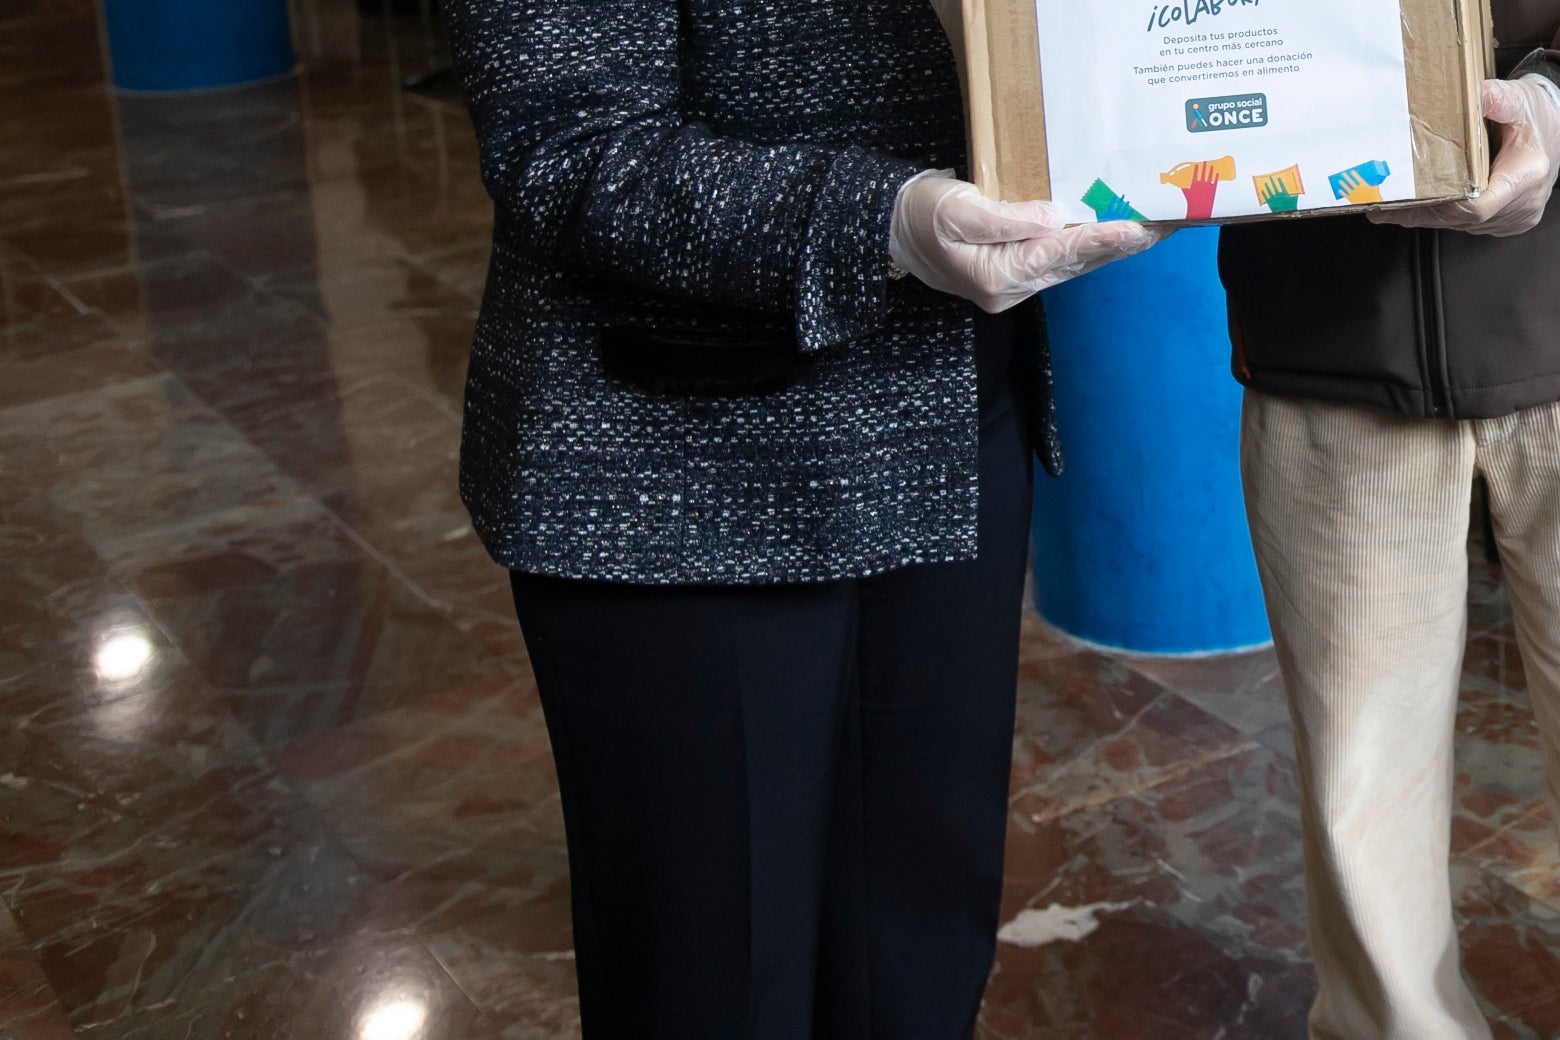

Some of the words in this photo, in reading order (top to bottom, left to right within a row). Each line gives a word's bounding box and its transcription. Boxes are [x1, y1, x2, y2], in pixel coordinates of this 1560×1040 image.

[1163, 33, 1207, 45] Deposita
[1210, 31, 1225, 41] tus
[1227, 27, 1278, 40] productos
[1159, 48, 1172, 56] en
[1174, 46, 1185, 55] tu
[1187, 44, 1219, 54] centro
[1221, 41, 1242, 51] más
[1244, 38, 1284, 49] cercano
[1133, 62, 1175, 75] También
[1177, 59, 1214, 72] puedes
[1216, 57, 1243, 68] hacer
[1246, 56, 1264, 65] una
[1266, 51, 1313, 63] donación
[1147, 77, 1166, 86] que
[1168, 70, 1239, 83] convertiremos
[1242, 68, 1254, 77] en
[1257, 64, 1300, 76] alimento
[1208, 100, 1236, 112] grupo
[1236, 97, 1263, 108] social
[1208, 108, 1264, 127] ONCE
